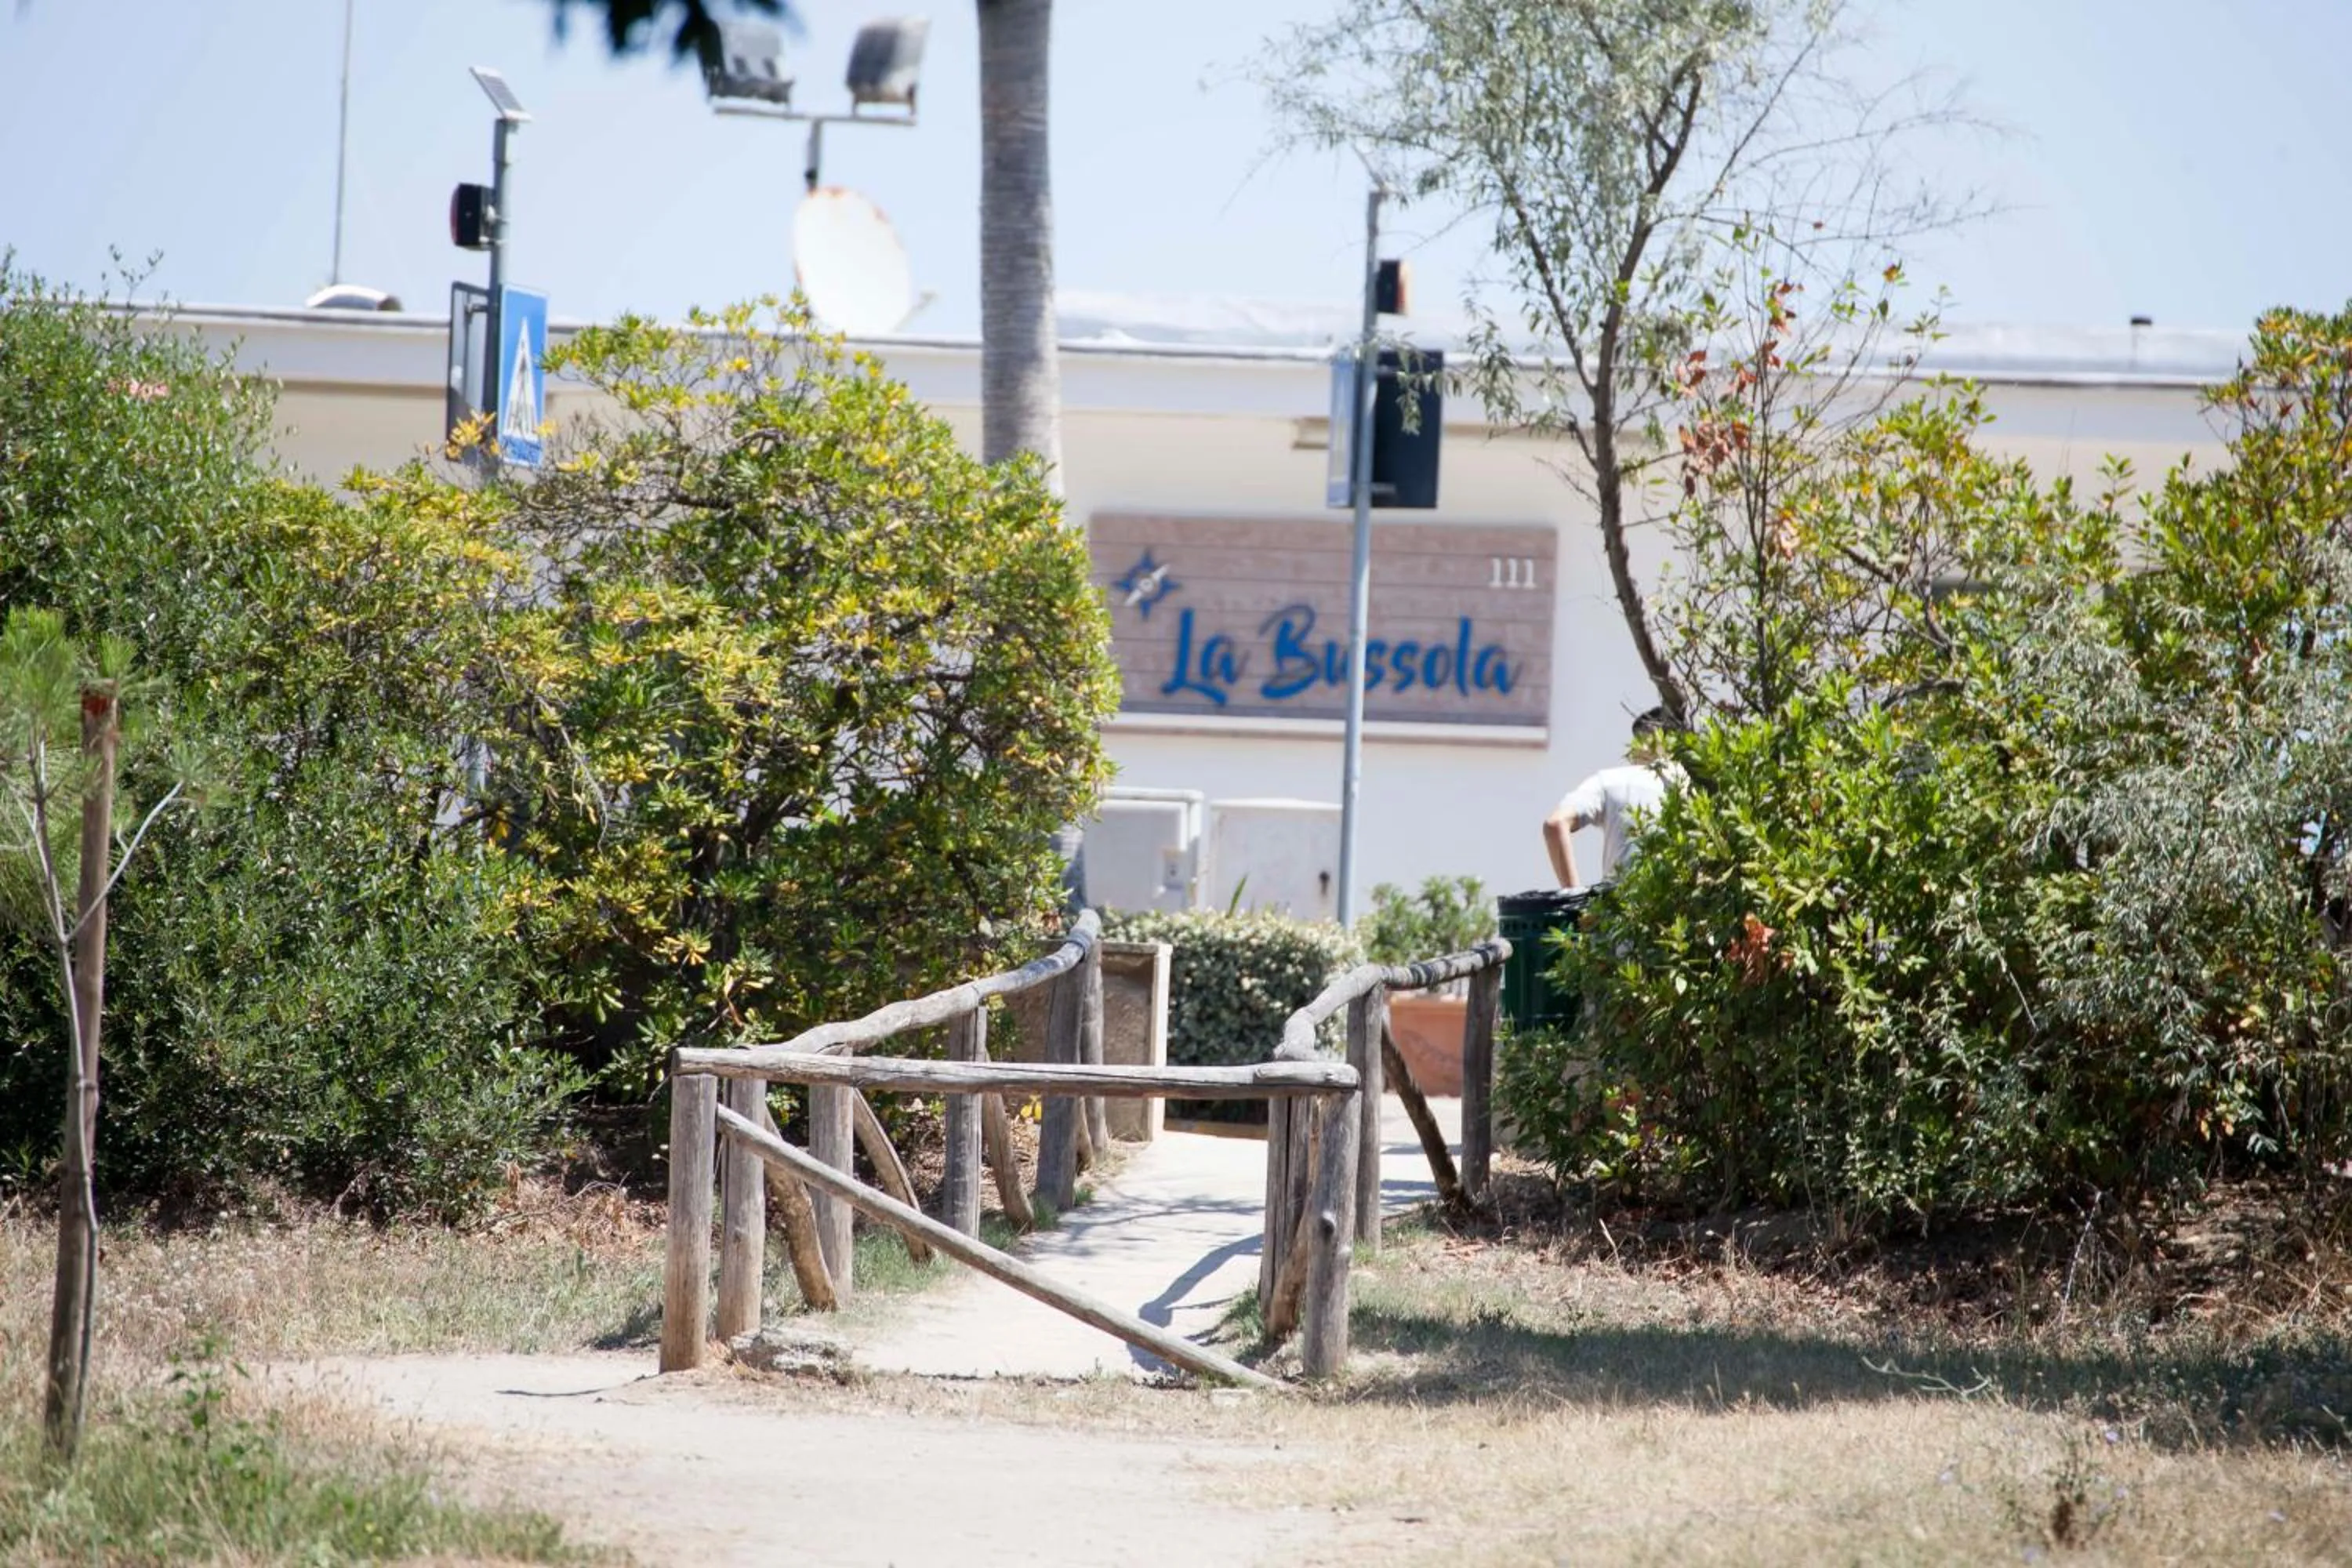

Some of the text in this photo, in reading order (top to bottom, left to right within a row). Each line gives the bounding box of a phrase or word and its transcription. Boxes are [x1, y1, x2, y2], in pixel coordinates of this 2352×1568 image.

[1490, 557, 1537, 589] 111
[1160, 604, 1523, 706] La Bussola
